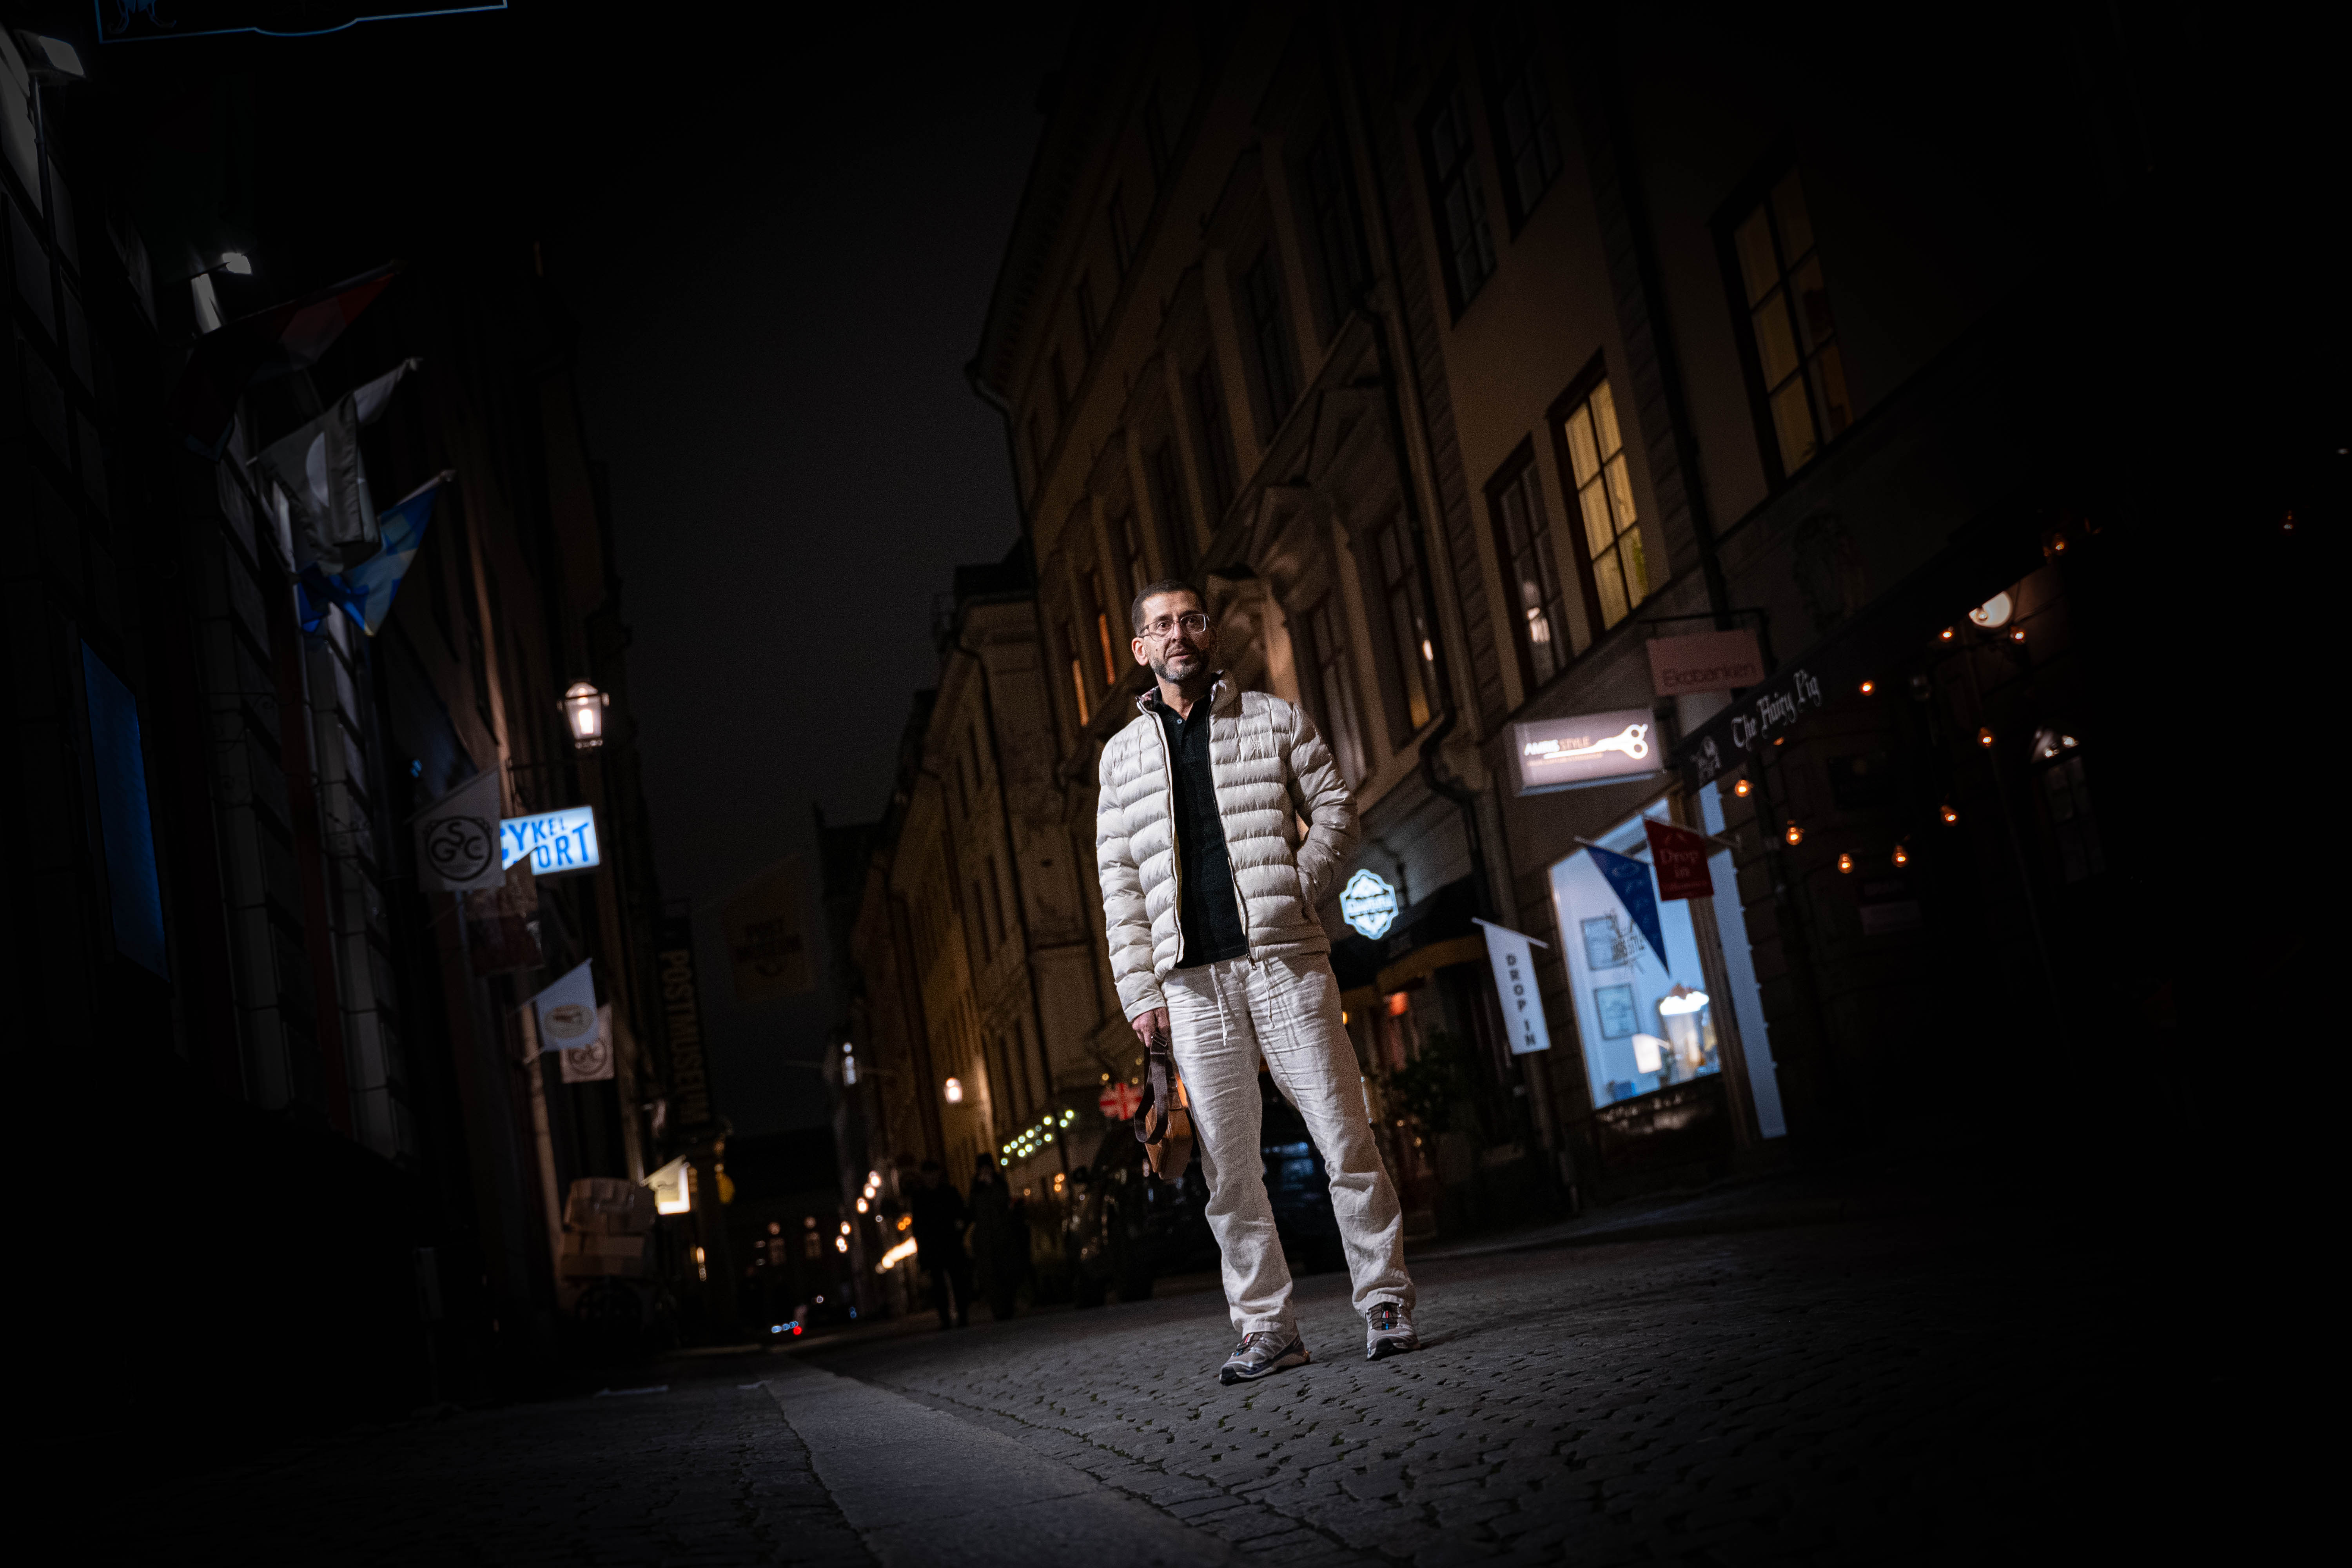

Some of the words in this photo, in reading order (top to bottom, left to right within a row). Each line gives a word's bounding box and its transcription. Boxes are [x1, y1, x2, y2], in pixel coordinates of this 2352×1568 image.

[1662, 662, 1757, 688] Ekobanken
[1731, 713, 1757, 752] The
[1756, 691, 1798, 740] Hairy
[1793, 668, 1823, 713] Pig
[500, 817, 567, 860] YKEL
[514, 822, 589, 868] ORT
[1659, 848, 1699, 866] Drop
